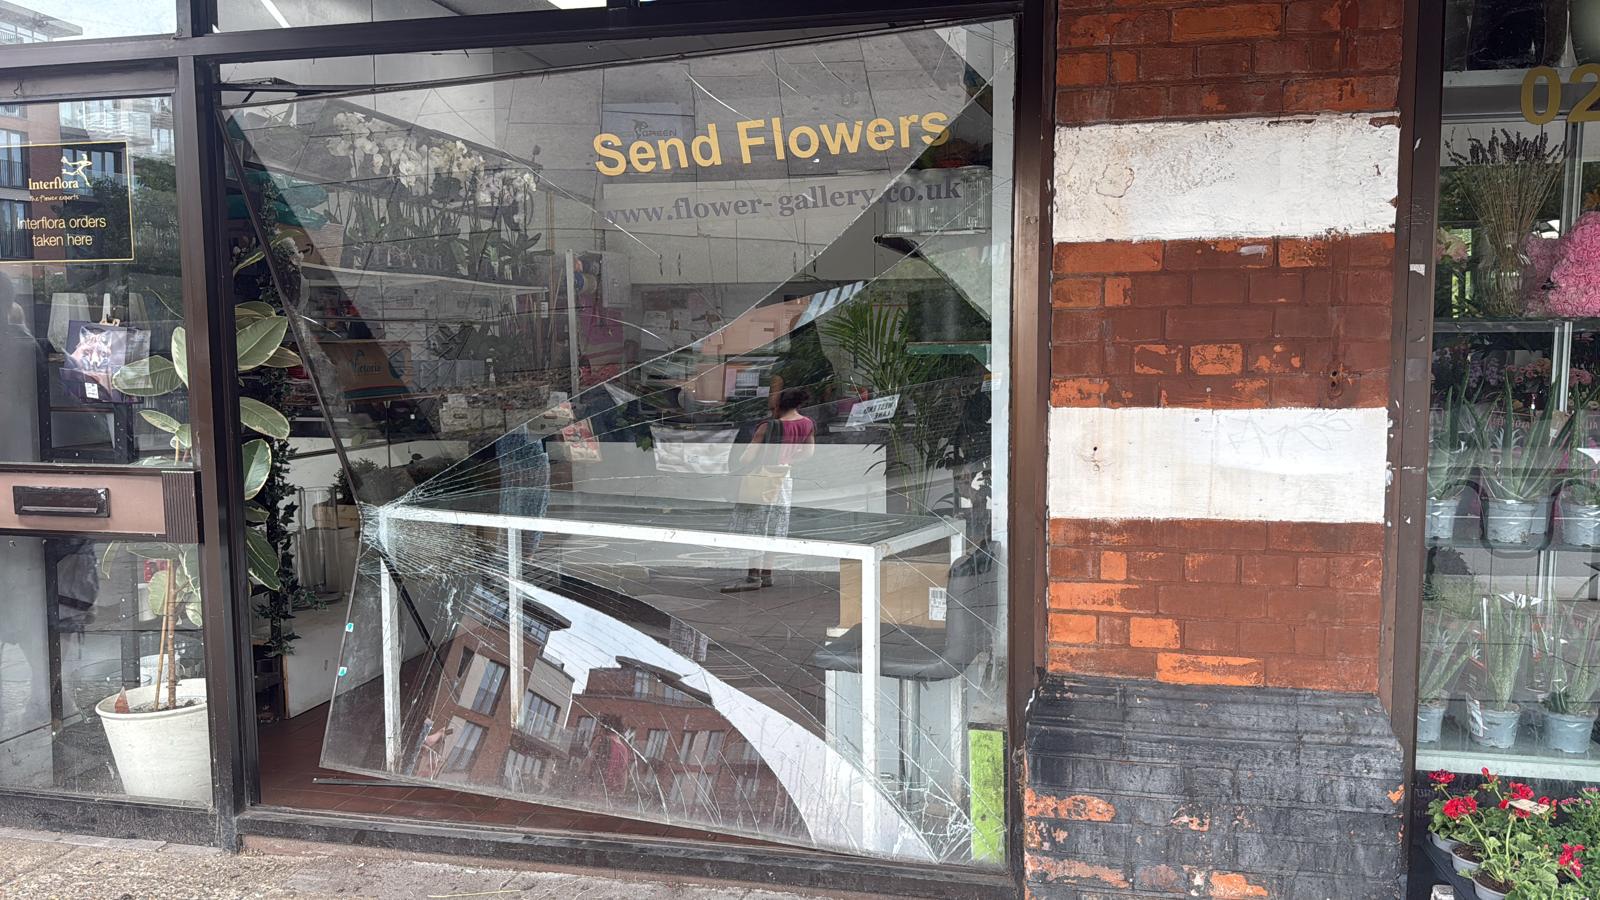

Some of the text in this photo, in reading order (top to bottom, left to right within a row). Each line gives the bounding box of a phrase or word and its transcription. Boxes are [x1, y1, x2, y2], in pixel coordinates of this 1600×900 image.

[593, 111, 950, 177] Send Flowers
[28, 177, 79, 190] Interflora
[17, 217, 107, 230] Interflora orders
[32, 233, 93, 247] taken here
